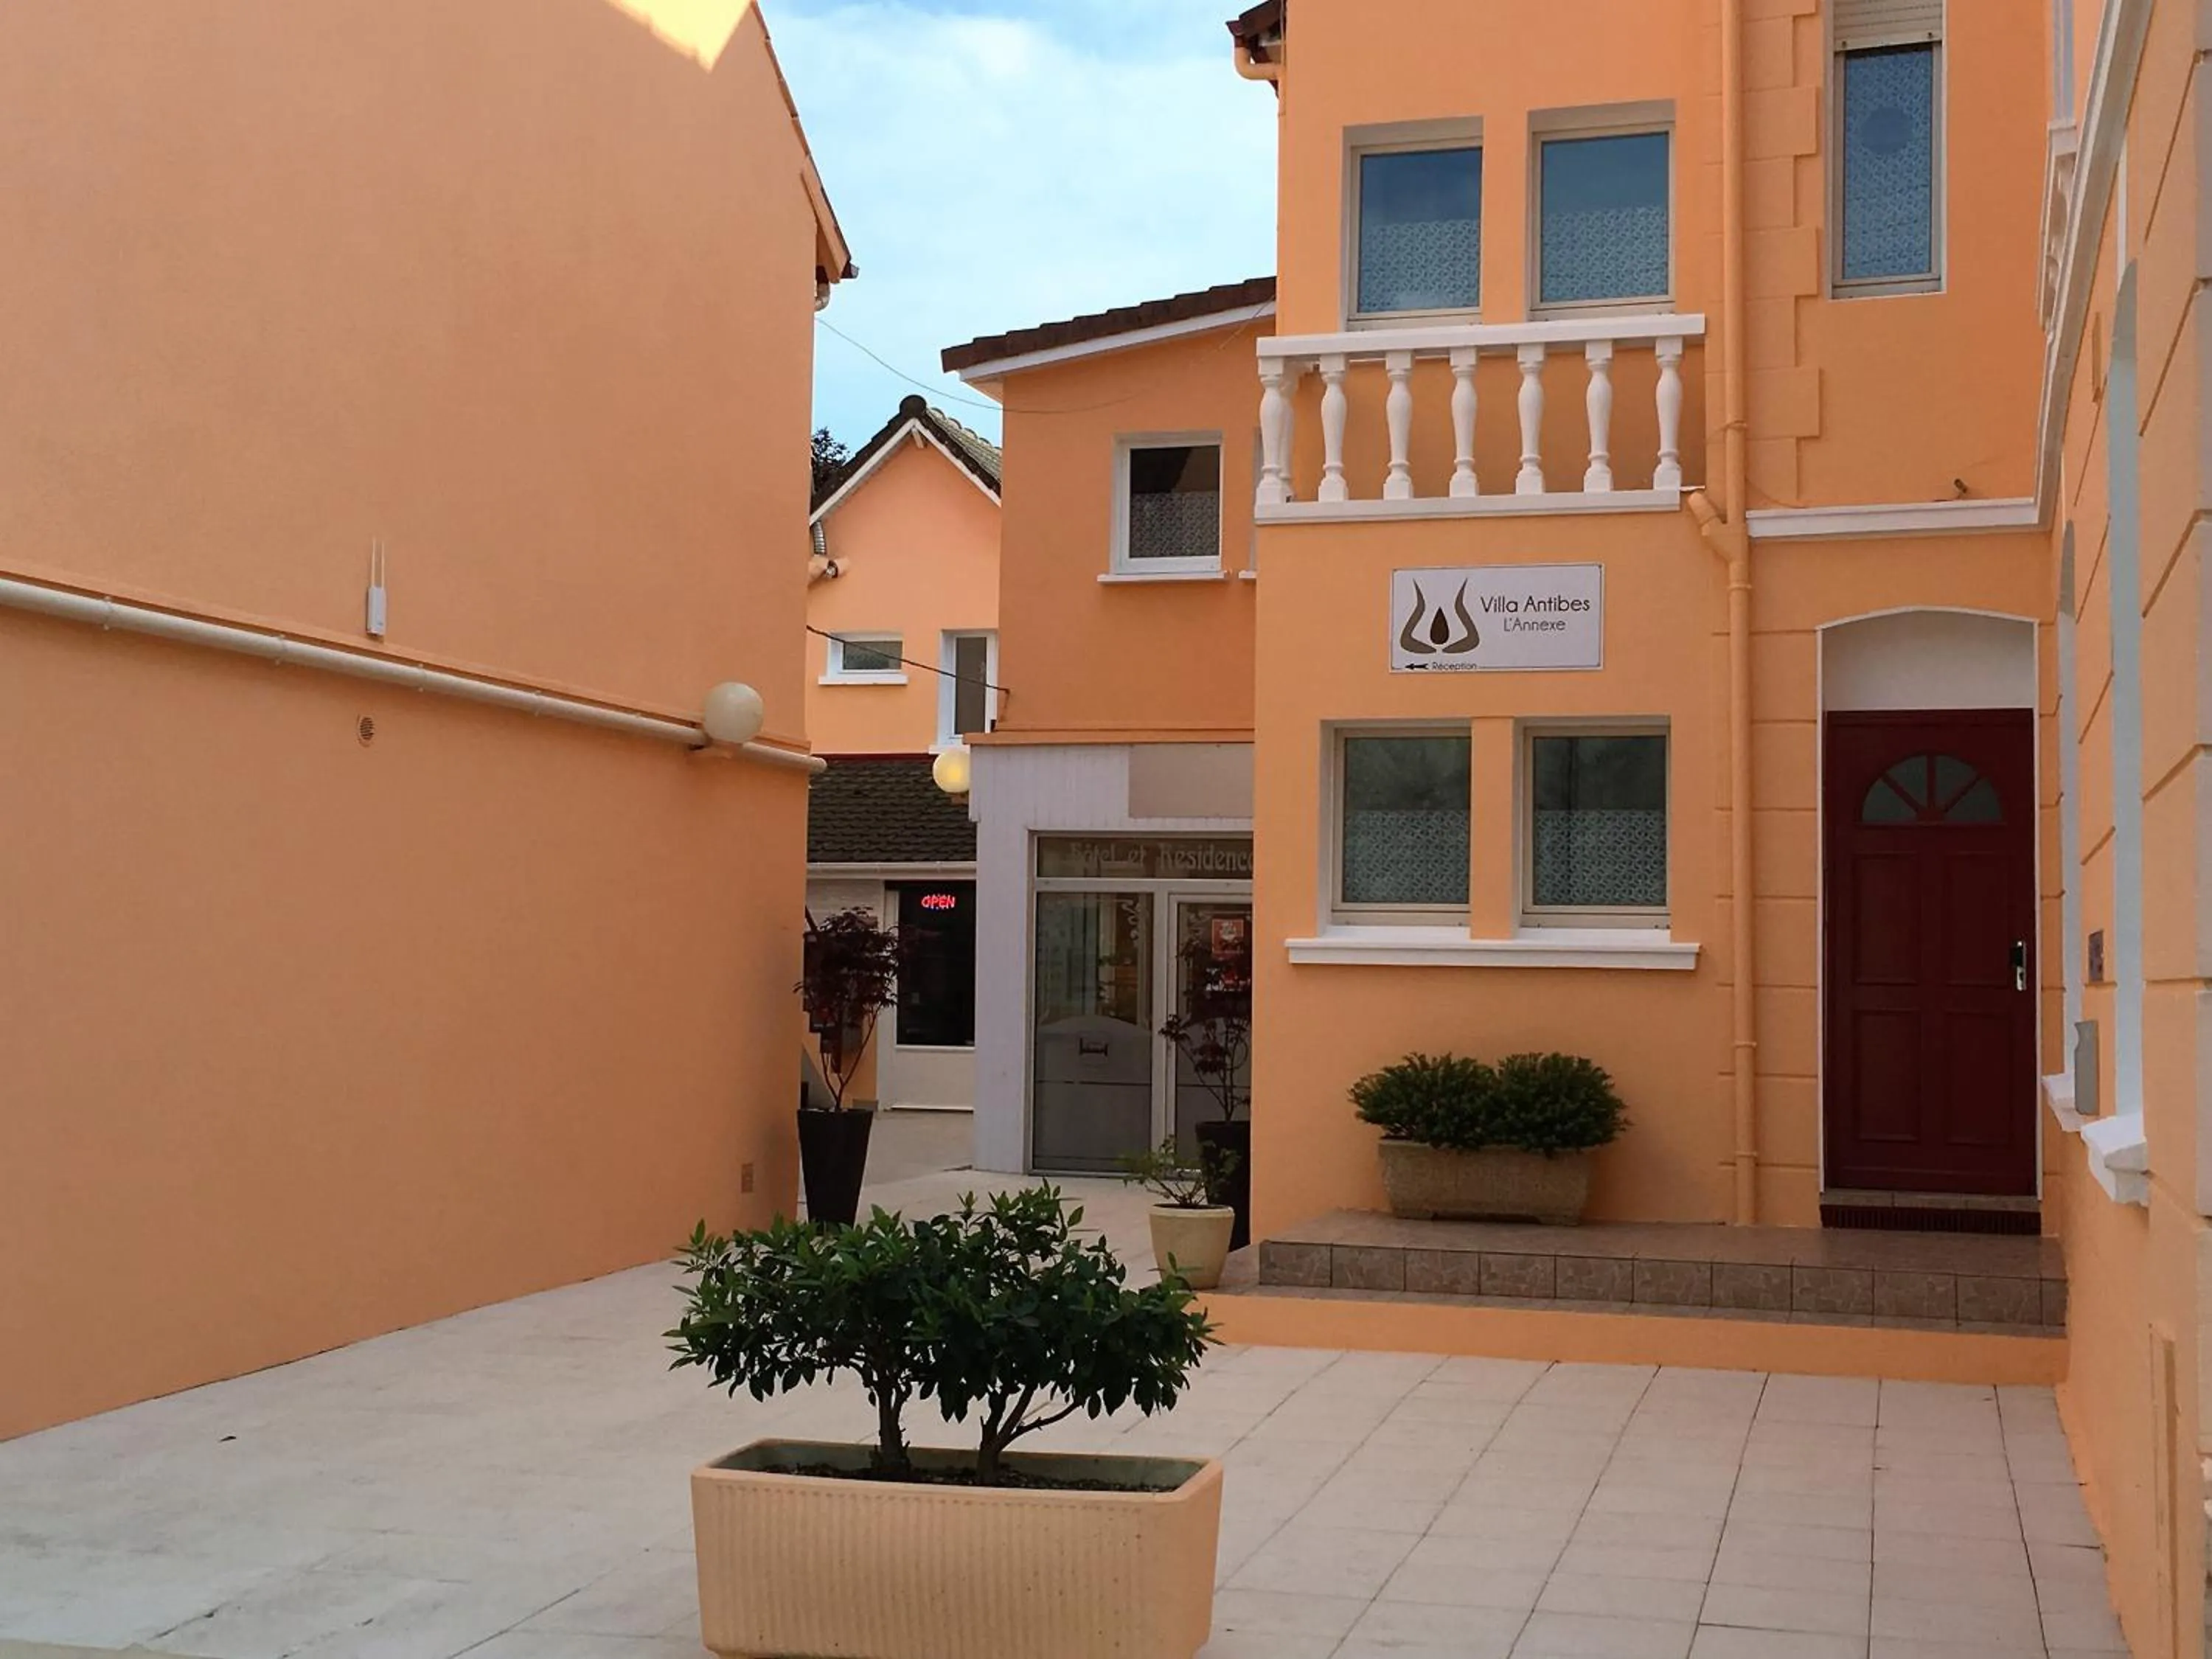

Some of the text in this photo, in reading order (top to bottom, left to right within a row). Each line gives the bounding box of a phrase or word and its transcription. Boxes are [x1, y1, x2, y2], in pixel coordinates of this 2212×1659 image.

[1480, 595, 1591, 613] Villa Antibes
[1503, 617, 1566, 632] L'Annexe
[1127, 844, 1147, 868] et
[921, 894, 956, 909] OPEN
